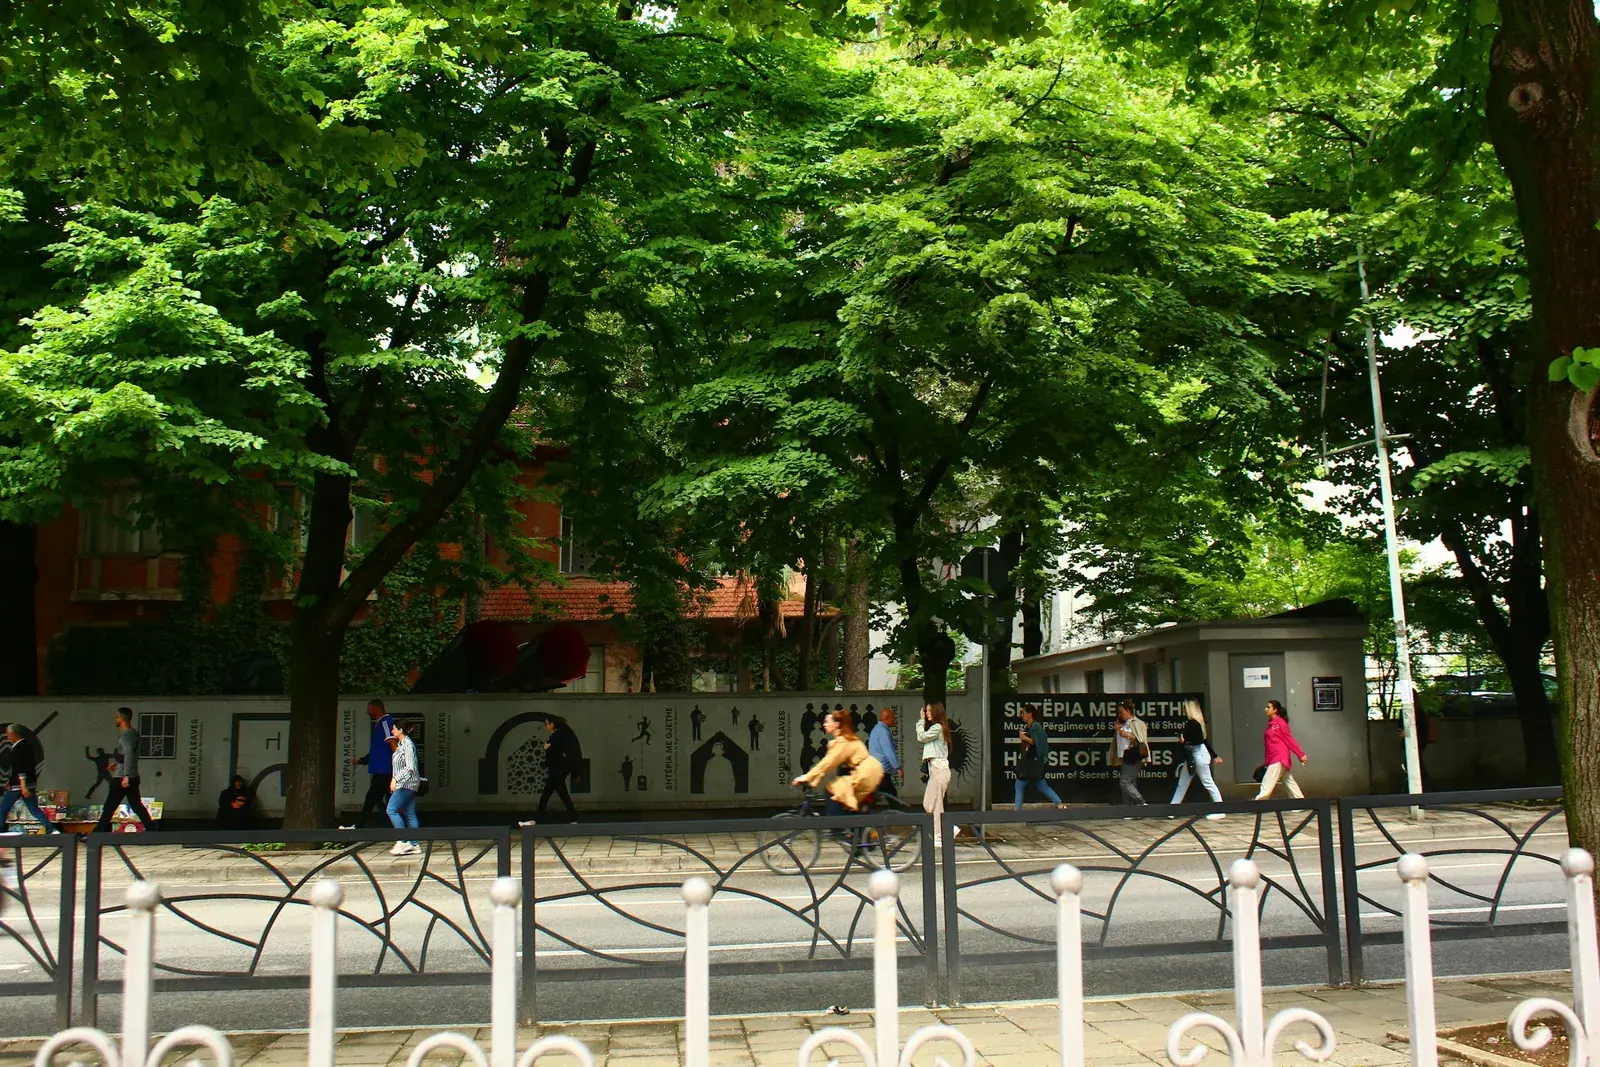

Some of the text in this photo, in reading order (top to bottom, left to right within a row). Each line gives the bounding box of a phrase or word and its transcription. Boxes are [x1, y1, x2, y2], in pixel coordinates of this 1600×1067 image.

[1042, 721, 1094, 732] Përgjimeve
[1096, 721, 1106, 730] të
[1151, 720, 1161, 729] të
[1089, 701, 1116, 717] ME
[1133, 701, 1187, 717] JETH
[188, 719, 199, 795] HOUSE OF LEAVES
[342, 709, 351, 794] SHTËPIA ME GJETHE
[437, 712, 446, 788] HOUSE OF LEAVES
[664, 707, 673, 790] SHTËPIA ME GJETHE
[778, 710, 786, 785] HOUSE OF LEAVES
[1004, 750, 1069, 767] HSE
[1074, 750, 1100, 766] OF
[1004, 770, 1018, 779] Th
[1067, 770, 1077, 779] of
[1079, 770, 1109, 779] Secret
